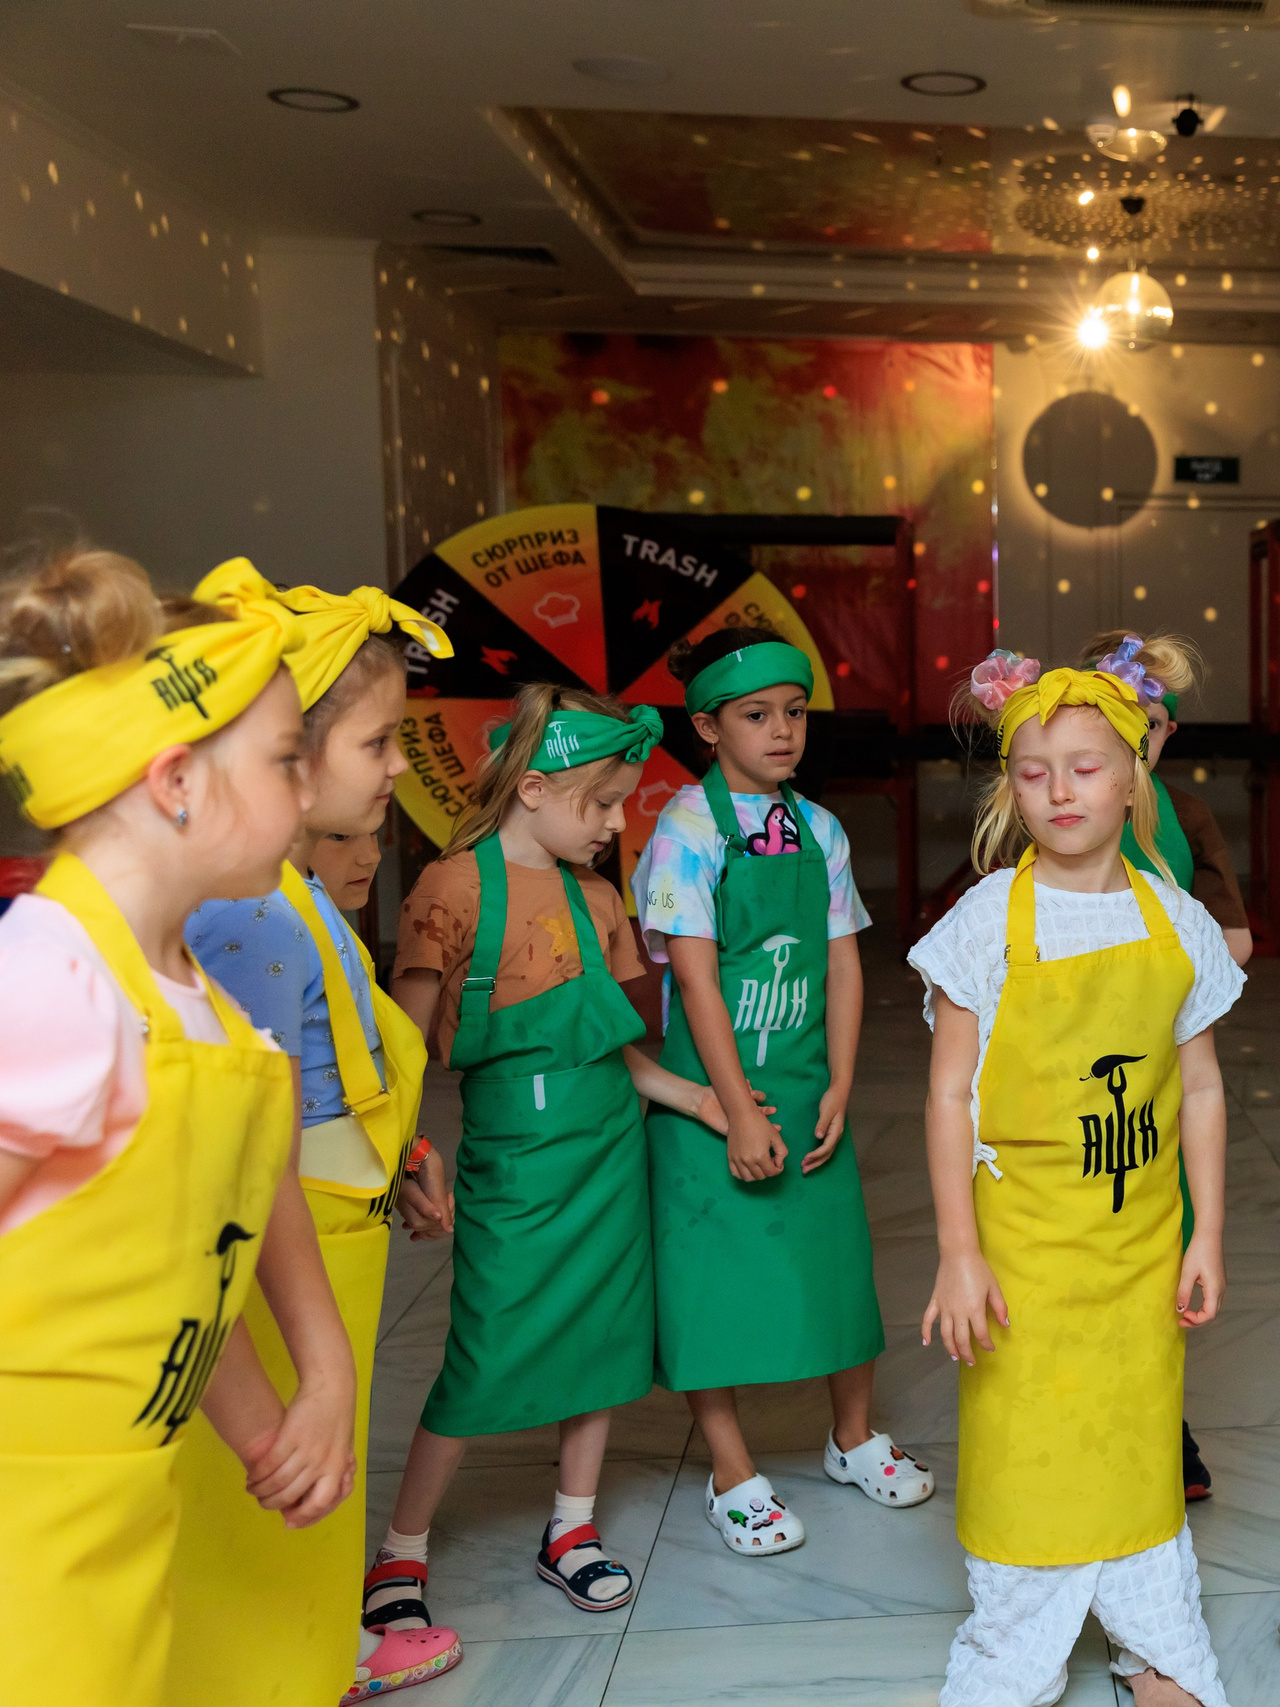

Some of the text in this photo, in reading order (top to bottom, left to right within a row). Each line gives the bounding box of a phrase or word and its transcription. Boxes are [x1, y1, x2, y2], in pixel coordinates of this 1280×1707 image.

[471, 528, 579, 568] СЮРПРИЗ
[485, 550, 586, 588] ОТ ШЕФА
[622, 533, 719, 588] TRASH
[404, 588, 460, 675] TRSH
[400, 717, 462, 817] СЮРПРИЗ
[424, 712, 466, 778] ШЕФА
[661, 892, 675, 909] US
